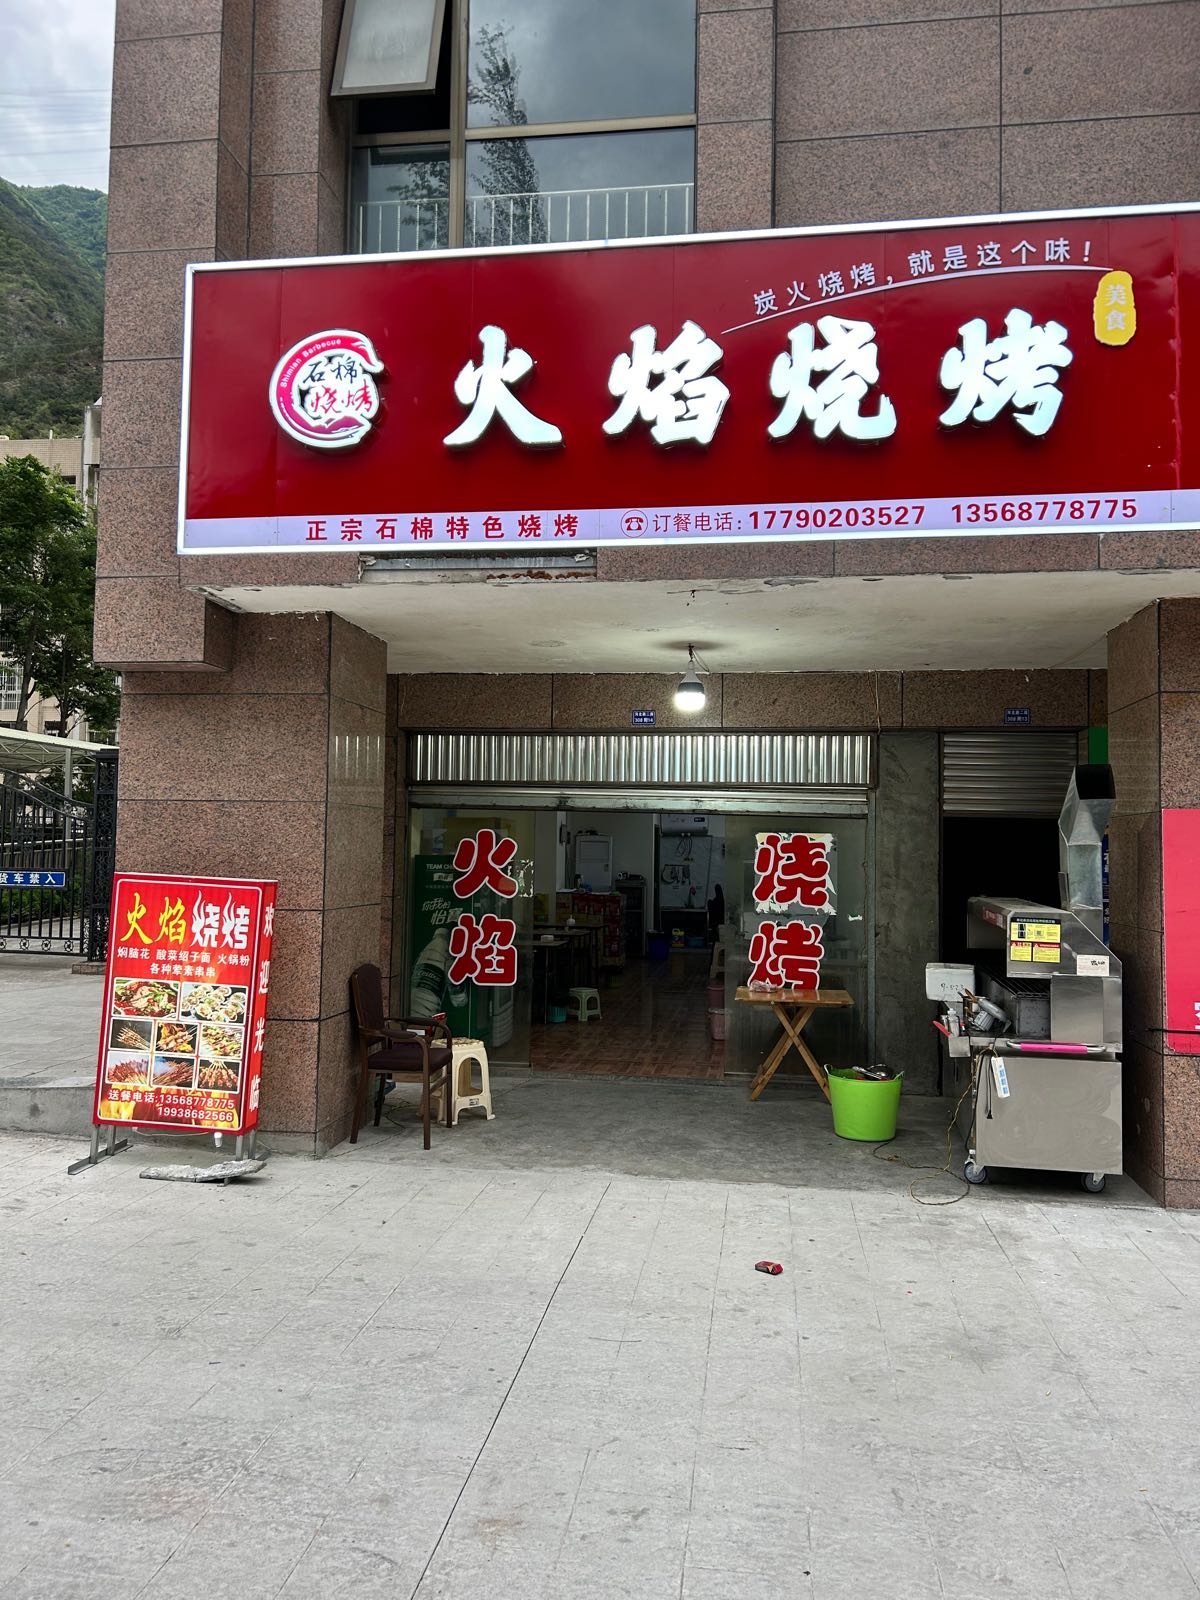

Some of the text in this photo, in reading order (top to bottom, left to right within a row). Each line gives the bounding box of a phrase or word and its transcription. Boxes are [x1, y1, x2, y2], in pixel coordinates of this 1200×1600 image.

[1105, 284, 1127, 333] 美食
[280, 338, 342, 388] Shimian Barbecue
[303, 356, 358, 384] 石棉
[443, 308, 1074, 448] 火焰烧烤
[310, 379, 372, 414] 烧烤
[305, 513, 580, 542] 正宗石棉特色烧烤
[951, 499, 1137, 524] 13568778775
[0, 872, 56, 884] 货车禁入
[119, 889, 251, 950] 火焰烧烤
[447, 828, 519, 987] 火焰
[748, 832, 831, 990] 烧烤
[216, 953, 251, 967] 火锅粉
[157, 1106, 234, 1122] 19938682566
